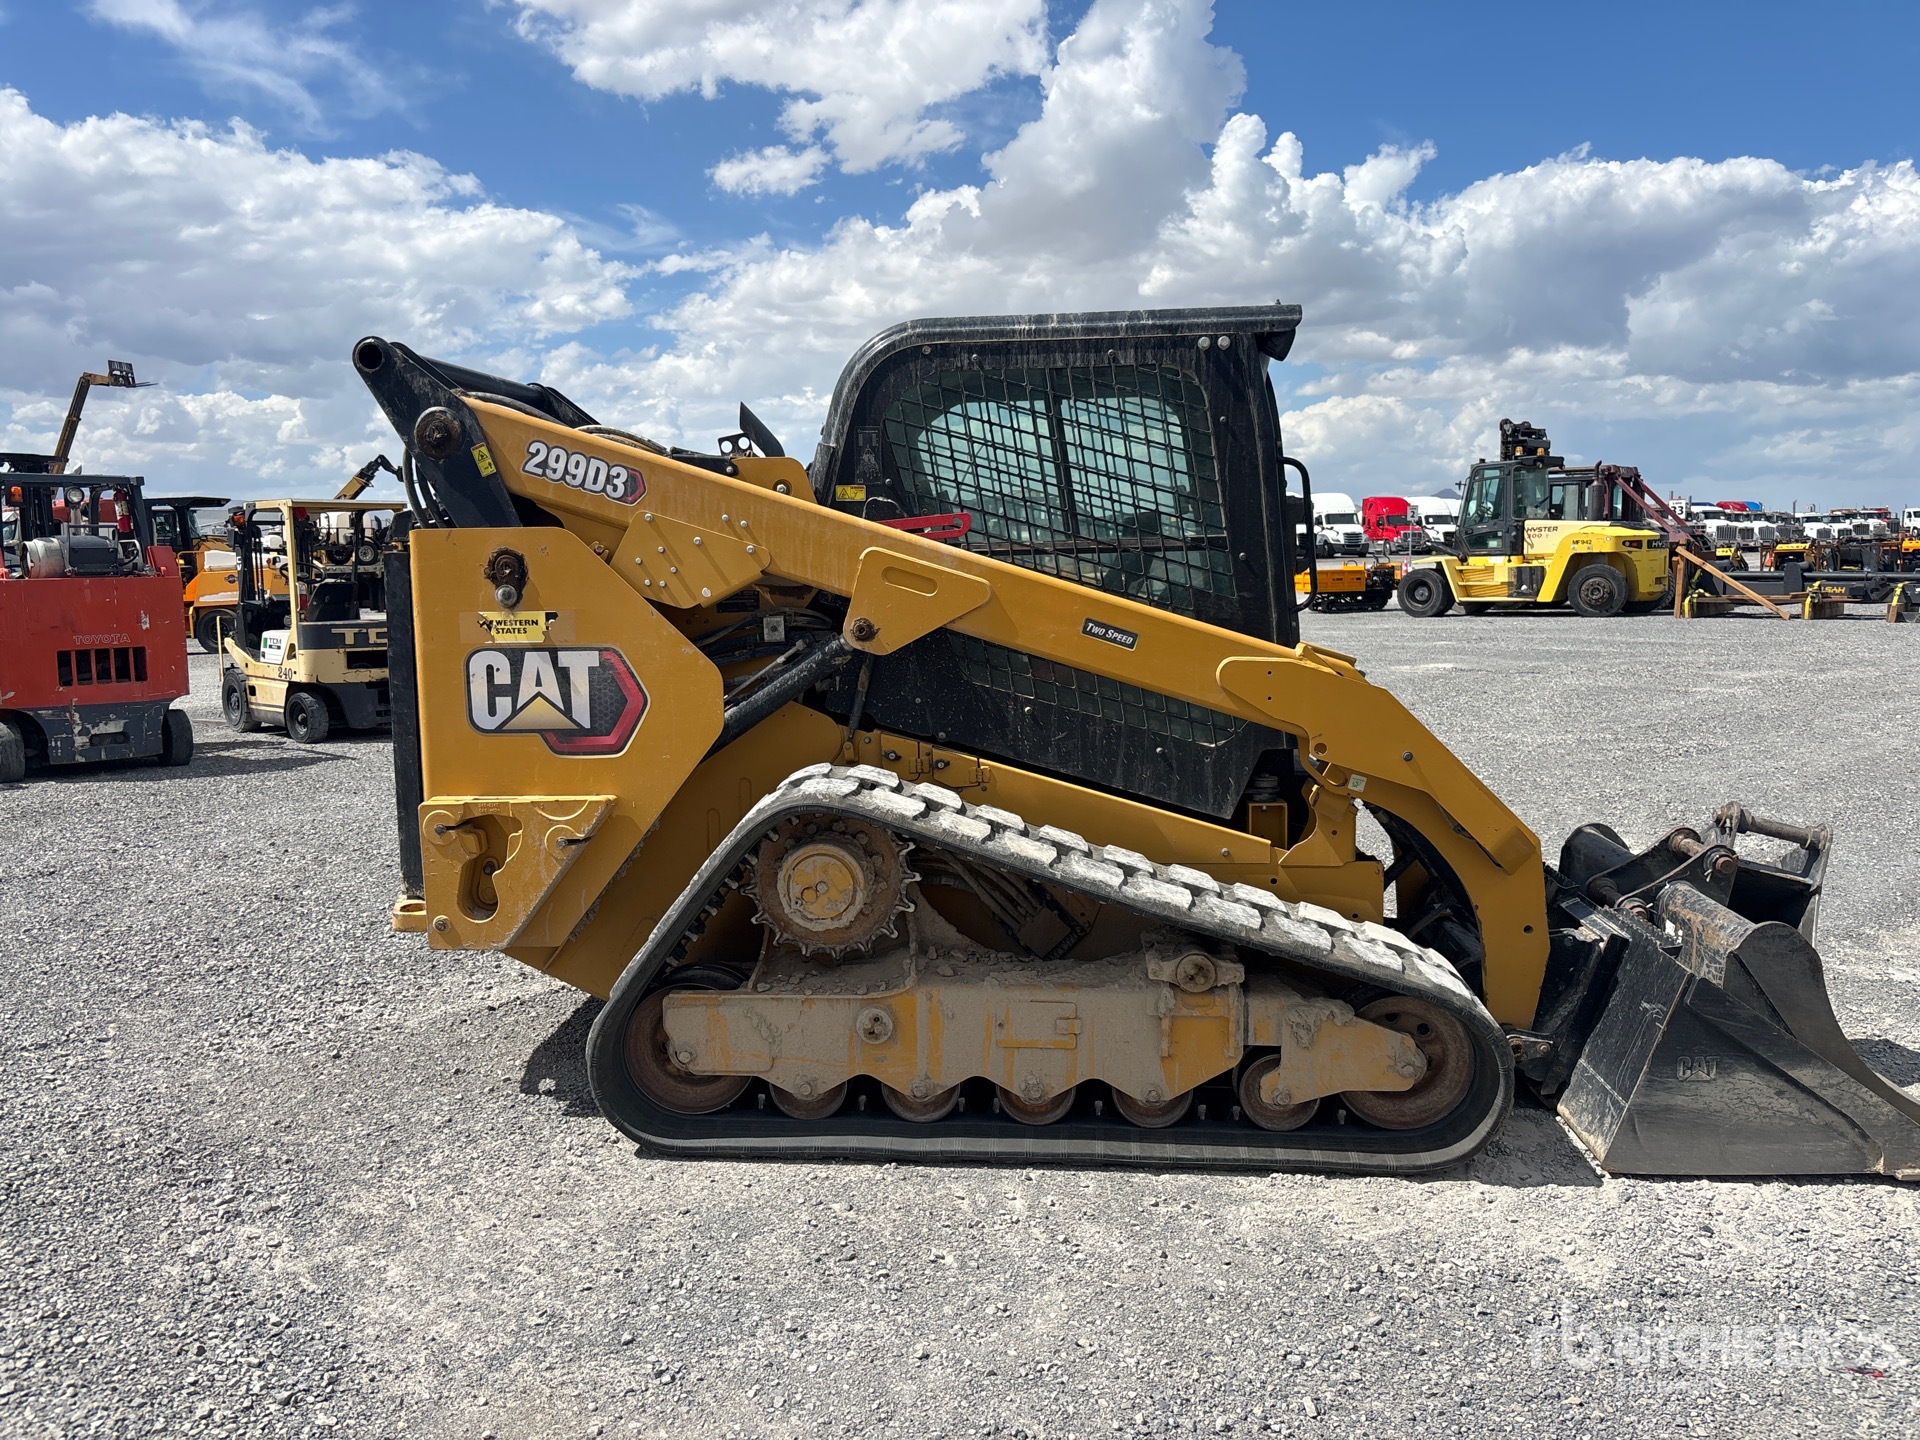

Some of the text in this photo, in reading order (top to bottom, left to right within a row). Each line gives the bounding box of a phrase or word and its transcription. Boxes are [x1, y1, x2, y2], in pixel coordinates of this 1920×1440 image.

[524, 441, 628, 498] 299D3
[1410, 511, 1416, 519] 2
[495, 619, 539, 627] WESTERN
[495, 627, 528, 635] STATES
[73, 633, 131, 645] TOYOTA
[278, 666, 293, 681] 240
[469, 650, 600, 730] CAT
[1676, 1055, 1720, 1081] CAT
